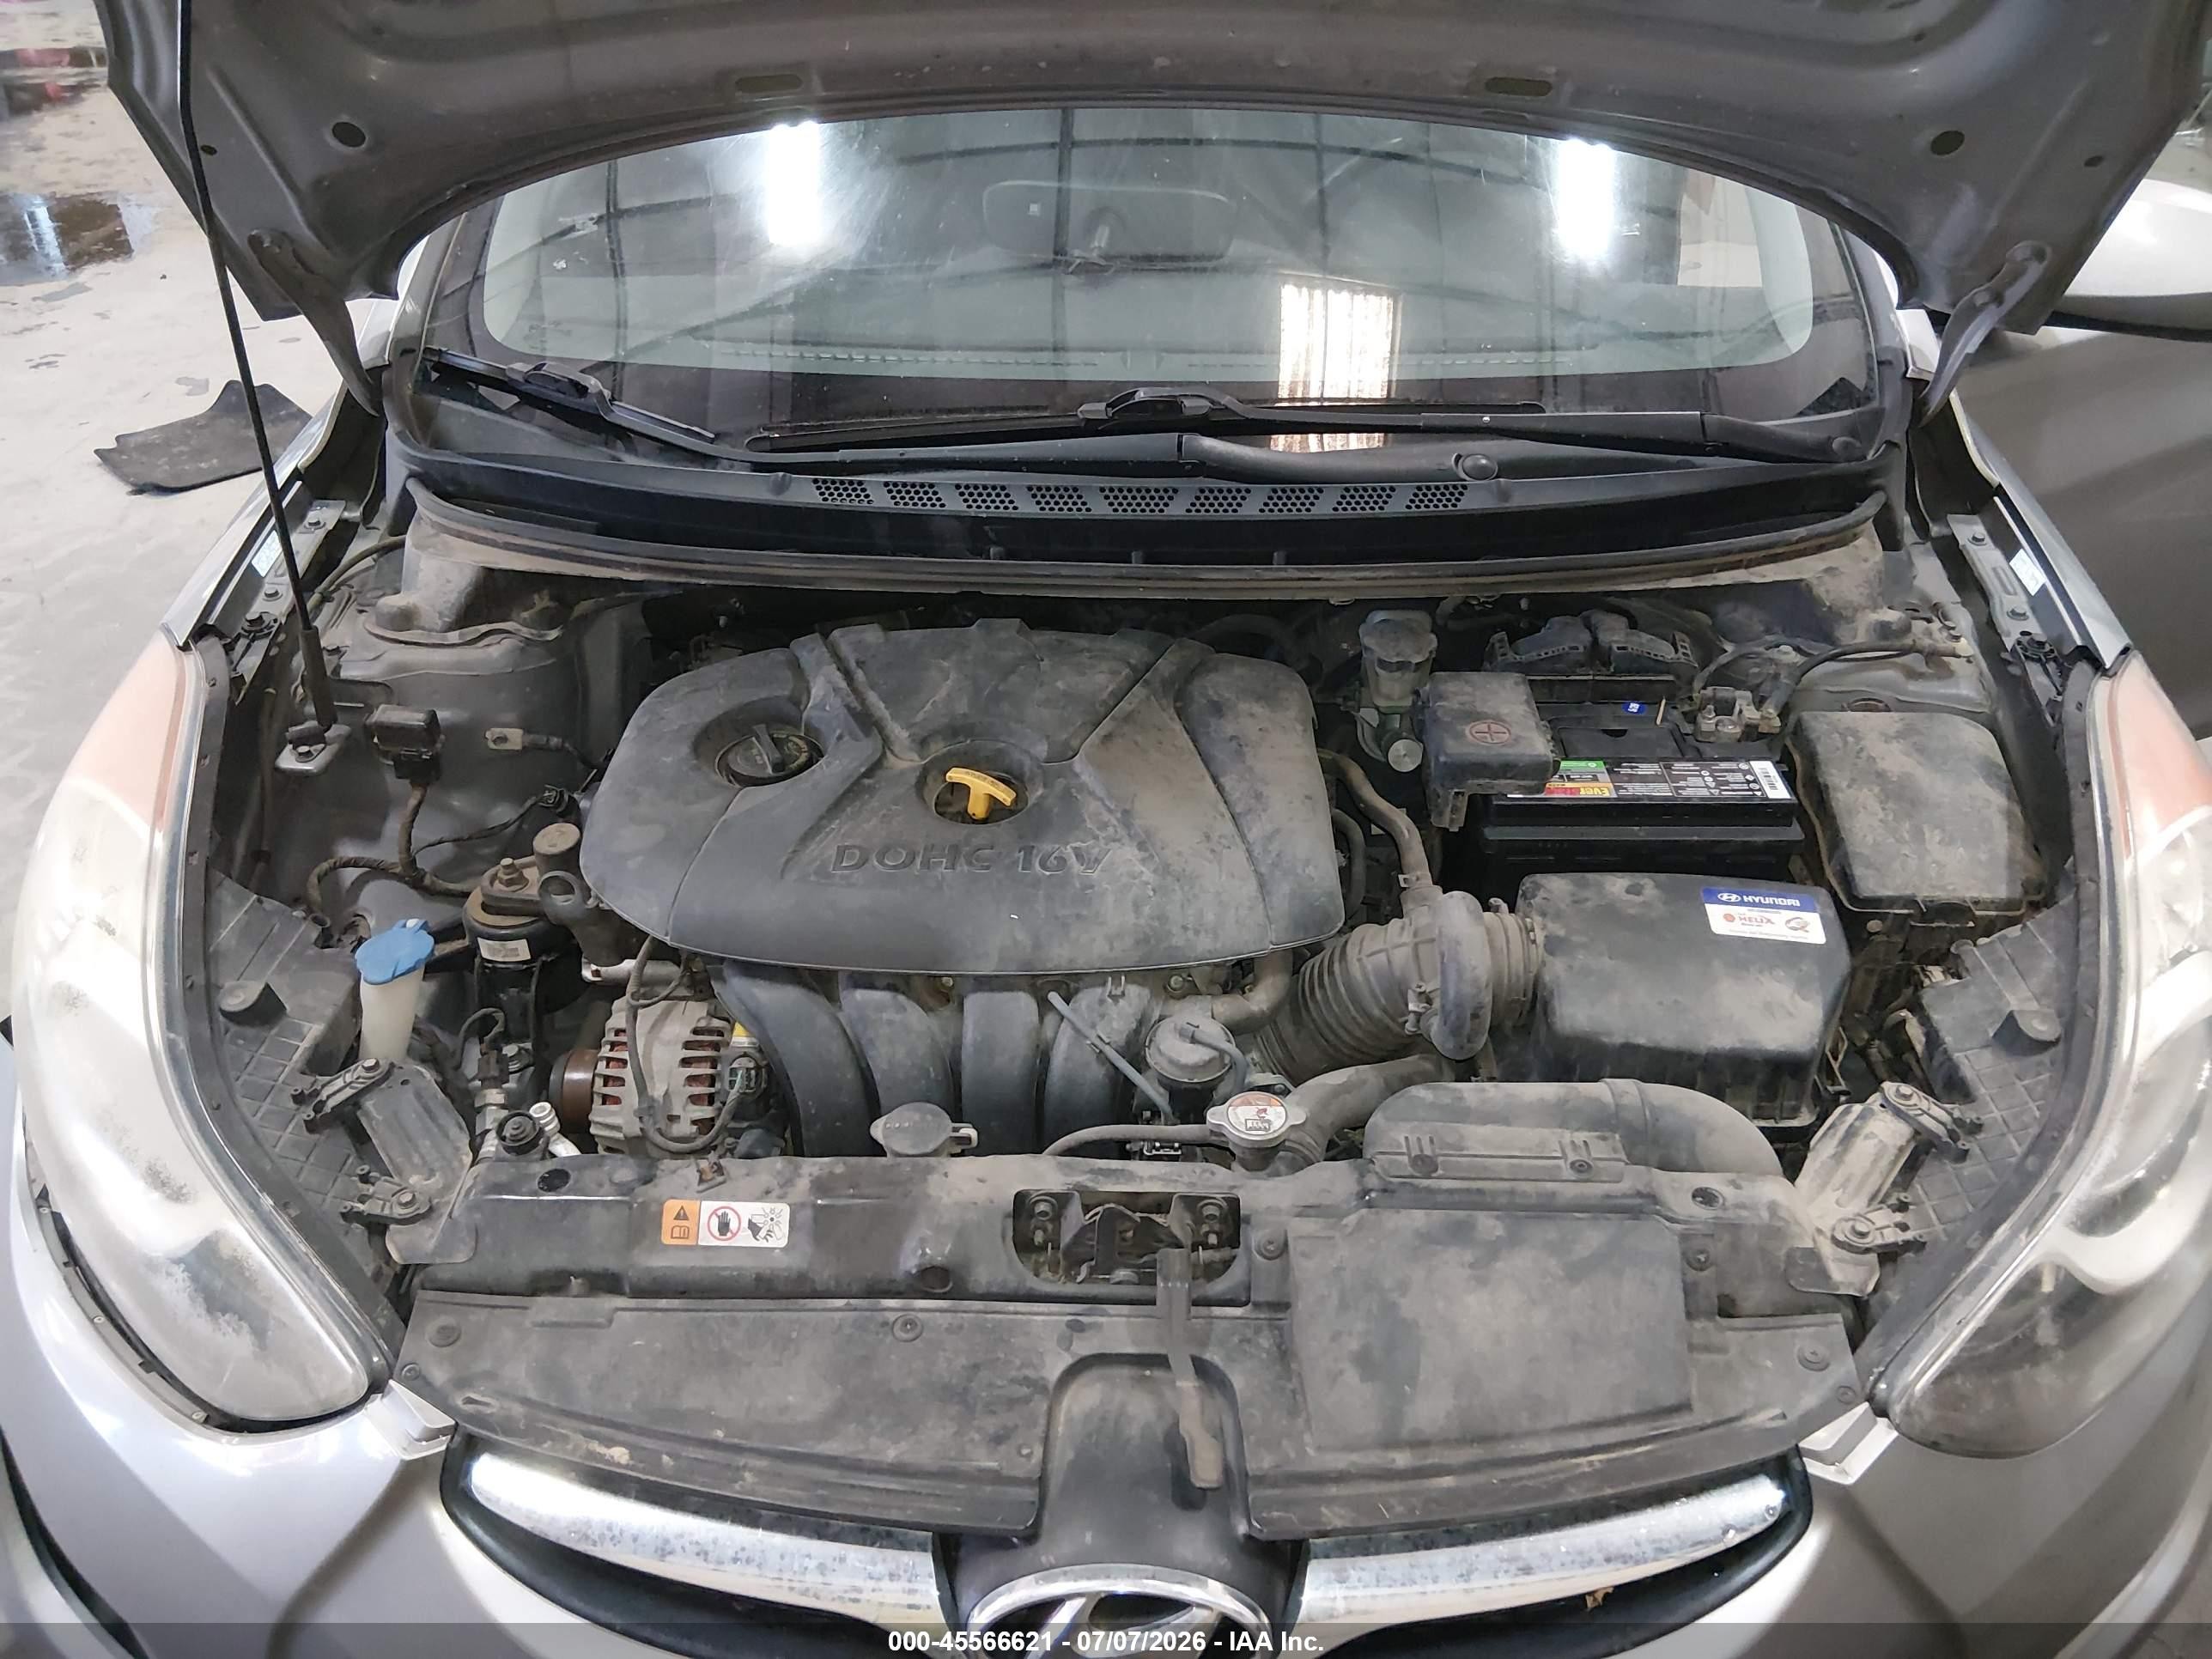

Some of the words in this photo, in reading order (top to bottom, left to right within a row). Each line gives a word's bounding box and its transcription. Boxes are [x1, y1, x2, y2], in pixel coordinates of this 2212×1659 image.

[831, 844, 994, 872] DOHC
[1016, 844, 1112, 875] 16V
[1743, 894, 1801, 907] HYUNDAI
[1739, 915, 1776, 925] HELIX
